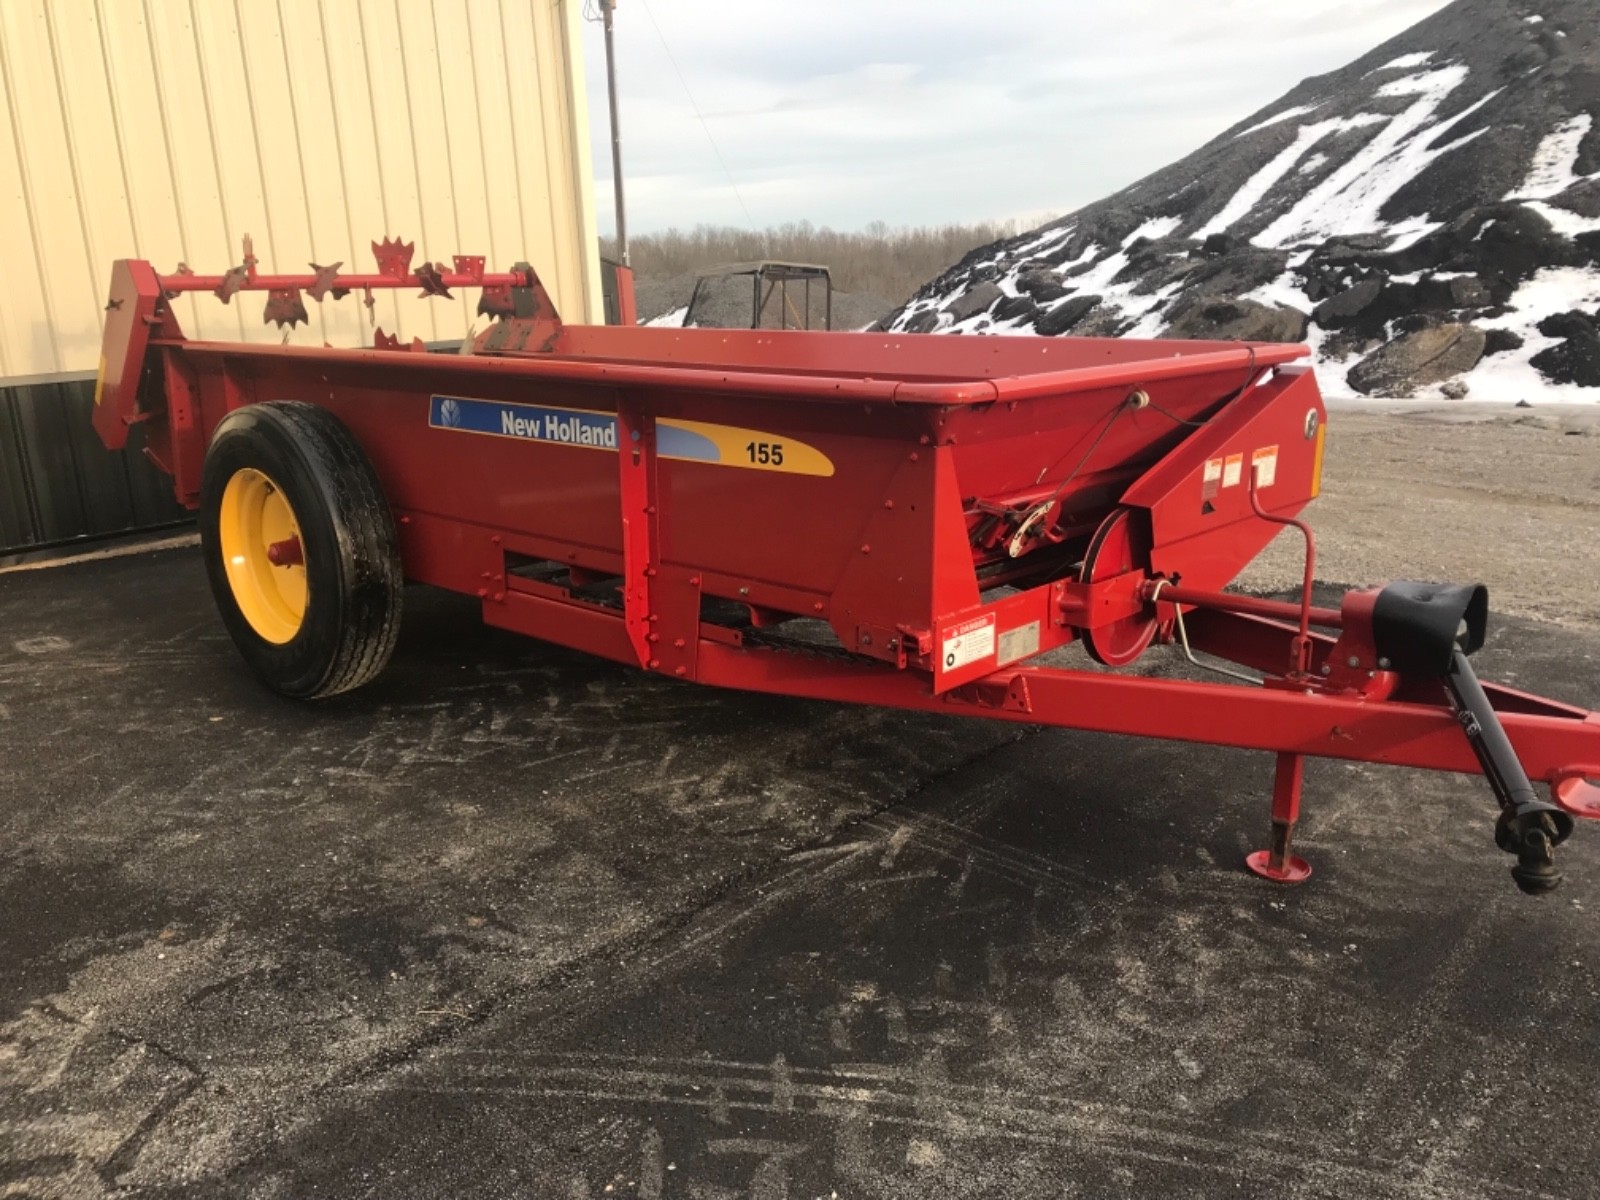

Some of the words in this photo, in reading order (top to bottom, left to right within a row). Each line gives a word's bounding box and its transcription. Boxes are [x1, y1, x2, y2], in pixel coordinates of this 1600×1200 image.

[501, 410, 540, 438] New
[545, 415, 616, 447] Holland
[746, 441, 783, 466] 155
